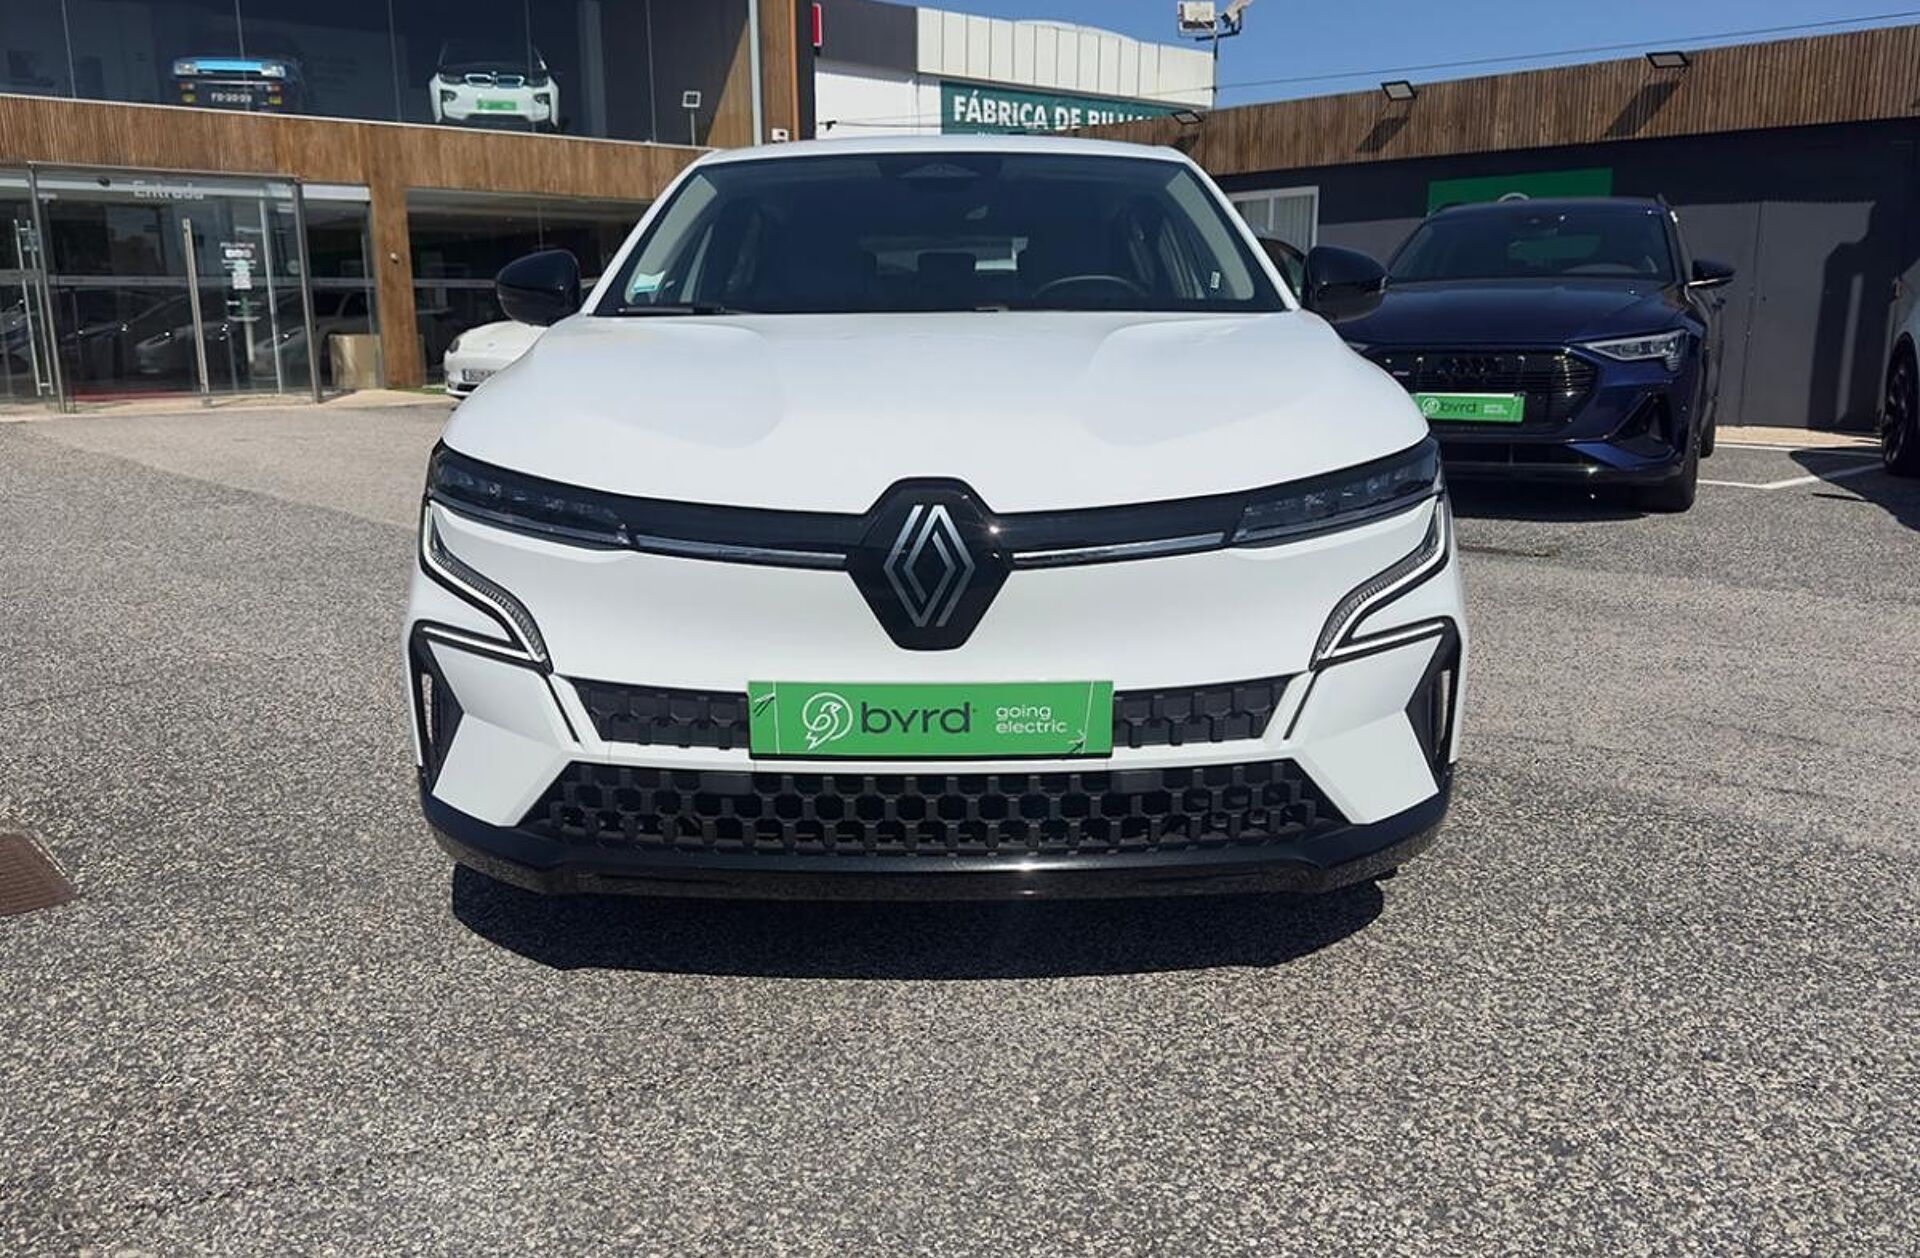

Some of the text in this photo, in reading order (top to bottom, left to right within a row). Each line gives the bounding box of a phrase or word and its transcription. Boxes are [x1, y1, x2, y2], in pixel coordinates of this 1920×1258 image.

[953, 90, 1050, 130] FÁBRICA
[1055, 107, 1082, 131] DE
[133, 180, 204, 200] Entrada
[861, 702, 970, 734] byrd
[995, 705, 1051, 721] going
[995, 719, 1068, 734] electric
